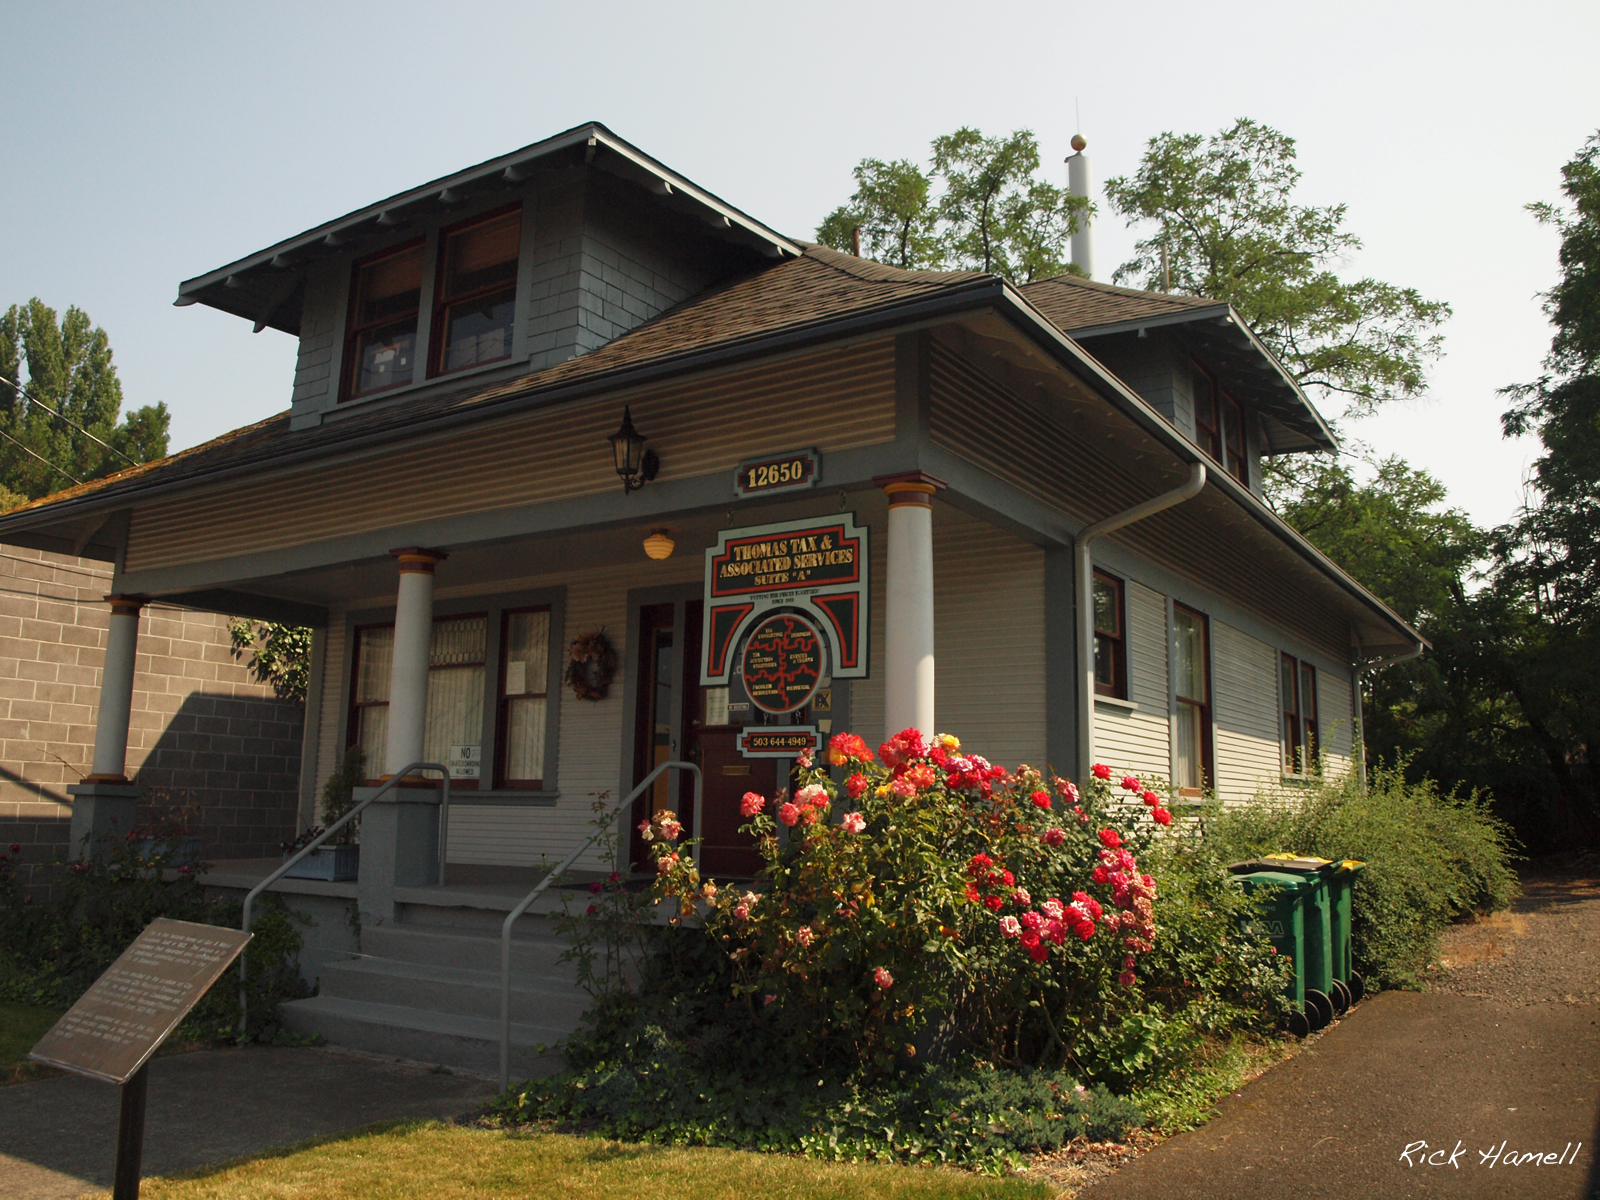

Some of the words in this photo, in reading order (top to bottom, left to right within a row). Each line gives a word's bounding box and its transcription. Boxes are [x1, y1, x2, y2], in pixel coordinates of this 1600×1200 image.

[748, 460, 803, 488] 12650
[734, 540, 788, 561] THOMAS
[789, 535, 818, 554] TAX
[820, 534, 833, 551] &
[720, 557, 791, 578] ASSOCIATED
[793, 548, 855, 569] SERVICES
[754, 572, 789, 586] SUITE
[791, 570, 811, 582] "A"
[753, 737, 769, 746] 503
[461, 747, 471, 759] NO
